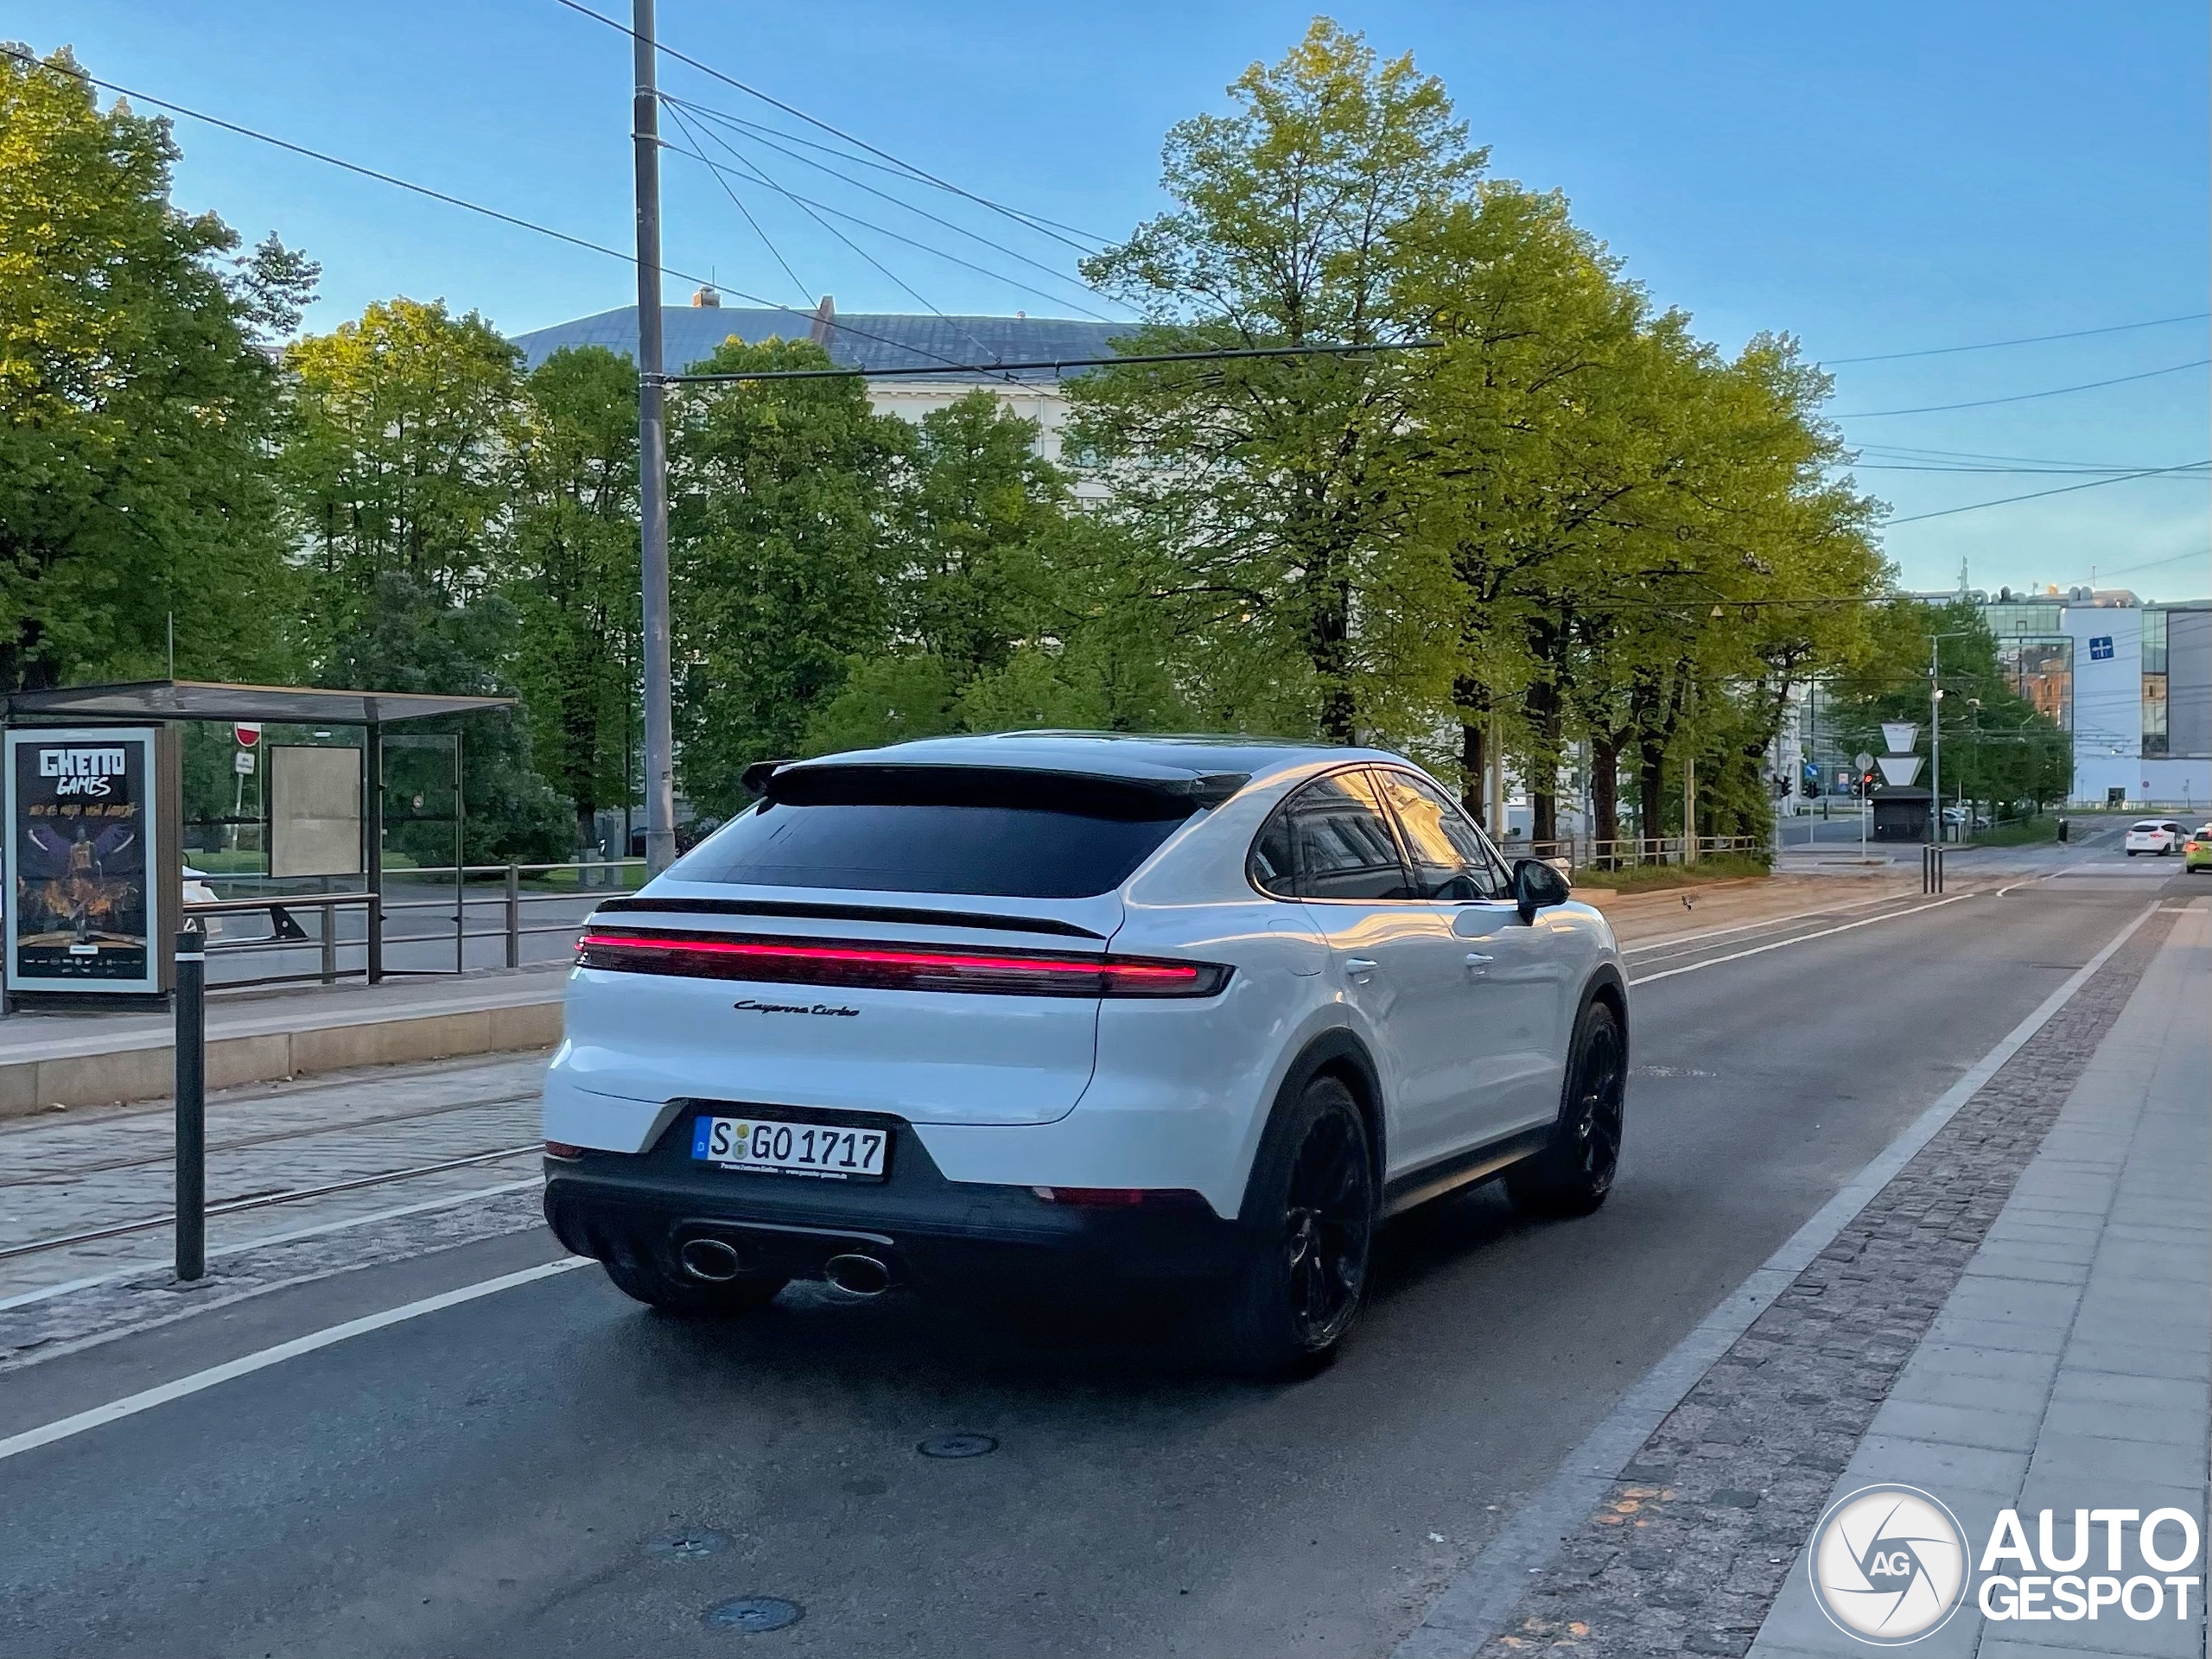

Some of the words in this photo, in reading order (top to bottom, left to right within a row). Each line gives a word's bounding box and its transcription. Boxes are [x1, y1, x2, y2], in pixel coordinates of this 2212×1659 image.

[40, 748, 125, 776] GHETTO
[56, 776, 111, 797] GAMES
[734, 1000, 809, 1014] Cayenne
[711, 1122, 732, 1155] S
[752, 1125, 792, 1160] GO
[798, 1129, 881, 1168] 1717
